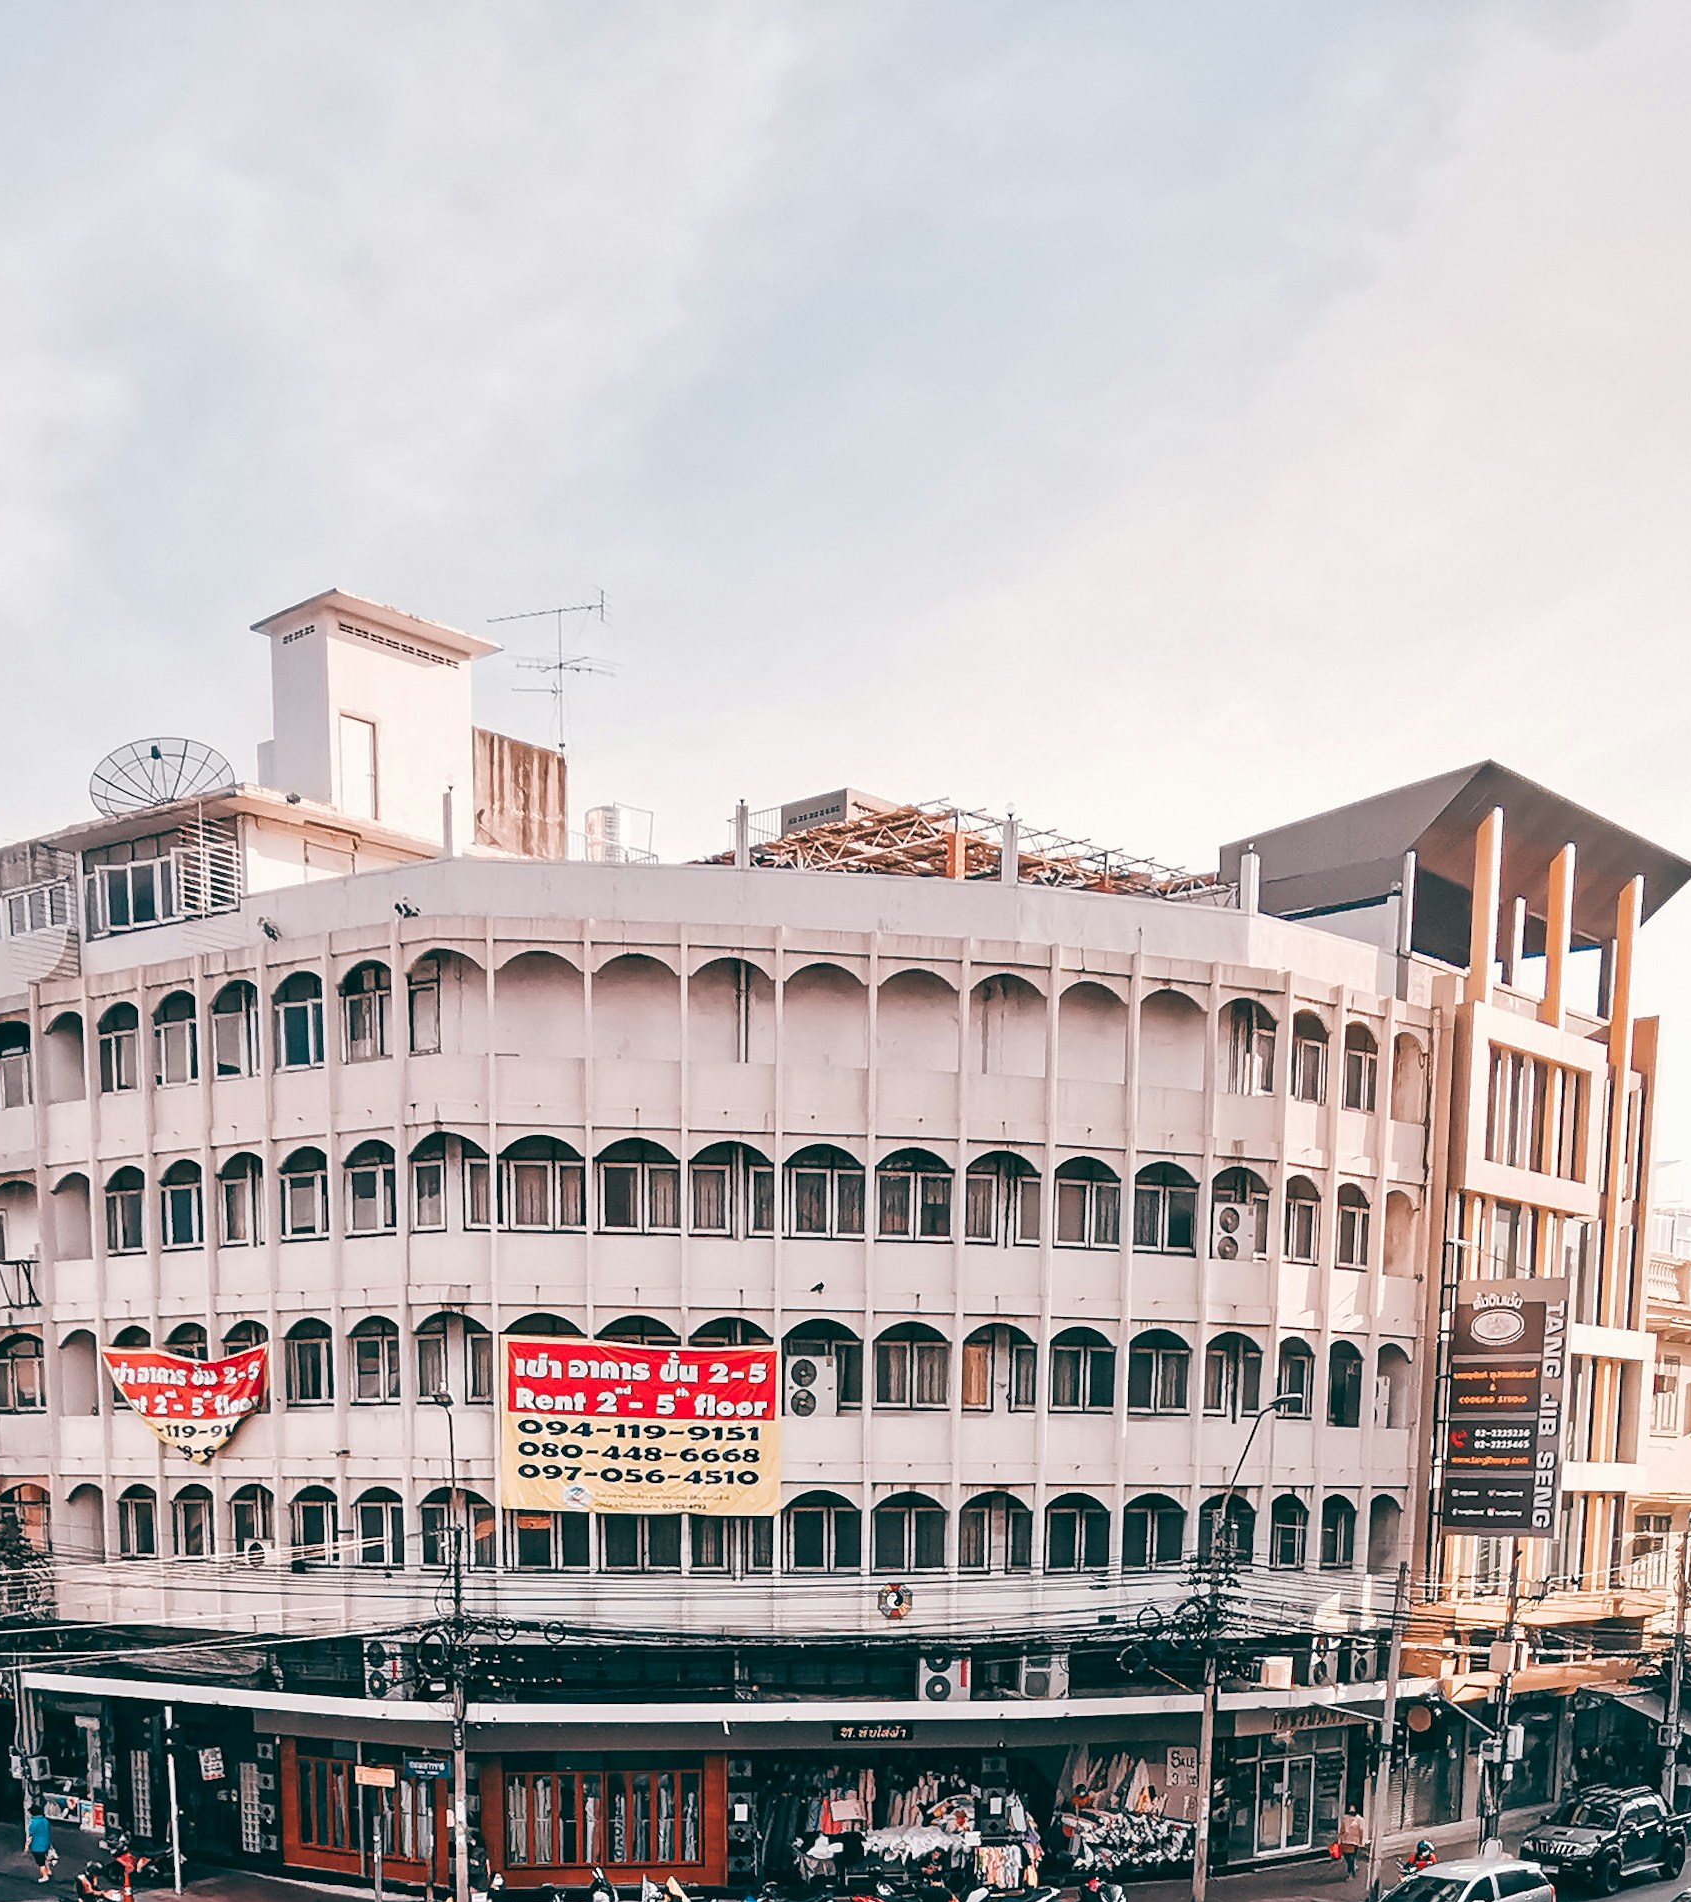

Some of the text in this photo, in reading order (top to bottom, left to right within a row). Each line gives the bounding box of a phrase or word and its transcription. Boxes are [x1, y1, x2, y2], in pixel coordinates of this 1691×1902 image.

[515, 1351, 768, 1385] เช่า อาคาร ชั้น 2-5
[515, 1387, 587, 1412] Rent
[694, 1394, 769, 1418] floor
[1531, 1300, 1565, 1530] TANG JIB SENG
[517, 1419, 760, 1442] 094-119-9151
[517, 1441, 760, 1464] 080-448-6668
[517, 1463, 759, 1486] 097-056-4510
